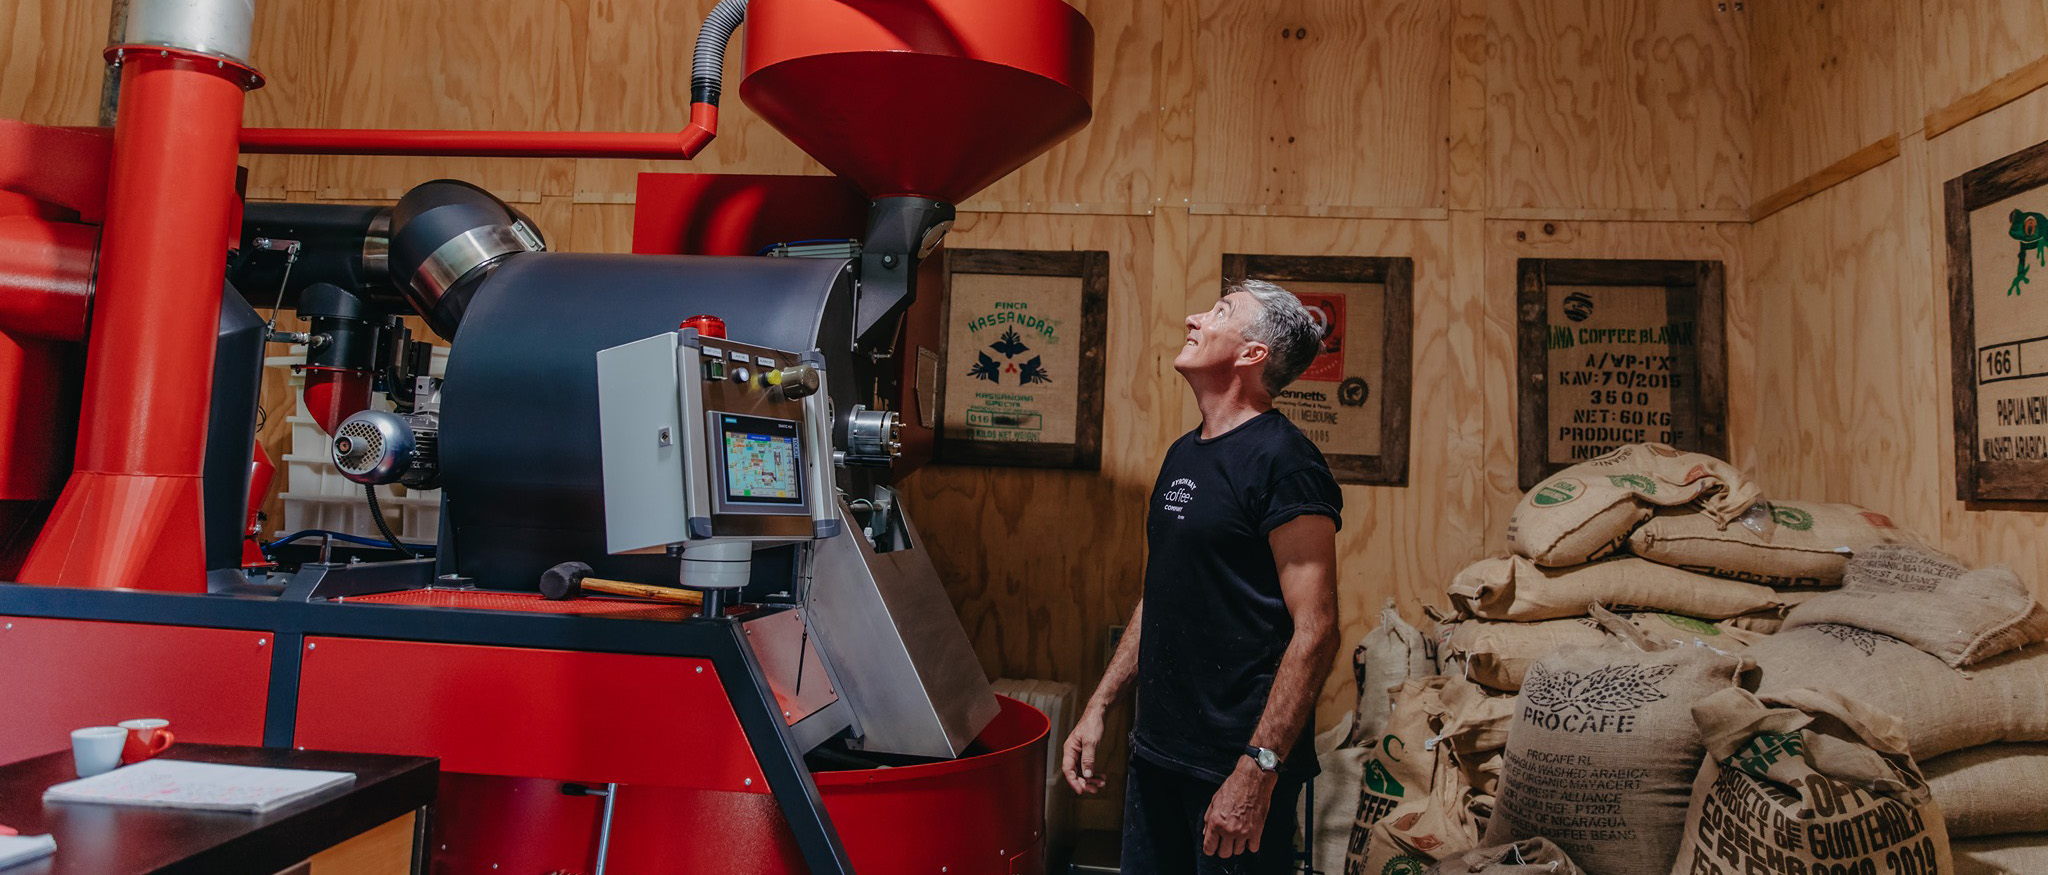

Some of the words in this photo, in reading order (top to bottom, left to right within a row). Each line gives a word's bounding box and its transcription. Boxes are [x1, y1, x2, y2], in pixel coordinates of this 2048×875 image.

[995, 302, 1028, 310] FINCA
[968, 311, 1055, 338] KASSANDRA
[1578, 328, 1637, 345] COFFEE
[1986, 350, 2011, 376] 166
[976, 392, 1034, 402] KASSANDRA
[970, 413, 989, 423] 016
[1301, 409, 1338, 424] MELBOURNE
[1997, 398, 2027, 427] PAPUA
[2027, 396, 2048, 425] NEW
[1560, 426, 1646, 443] PRODUCE
[1660, 430, 1684, 444] OF
[1571, 445, 1617, 459] INDO
[1523, 706, 1636, 733] PROCAFE
[1527, 748, 1575, 765] PROCAFE
[1537, 764, 1587, 779] WASHED
[1590, 768, 1649, 779] ARABICA
[1522, 772, 1568, 789] ORGANIC
[1559, 791, 1624, 804] ALLIANCE
[1711, 774, 1769, 839] PRODUCT
[1551, 815, 1627, 828] NICARAGUA
[1807, 798, 1926, 860] GUATEMALA
[1590, 830, 1636, 841] BEANS
